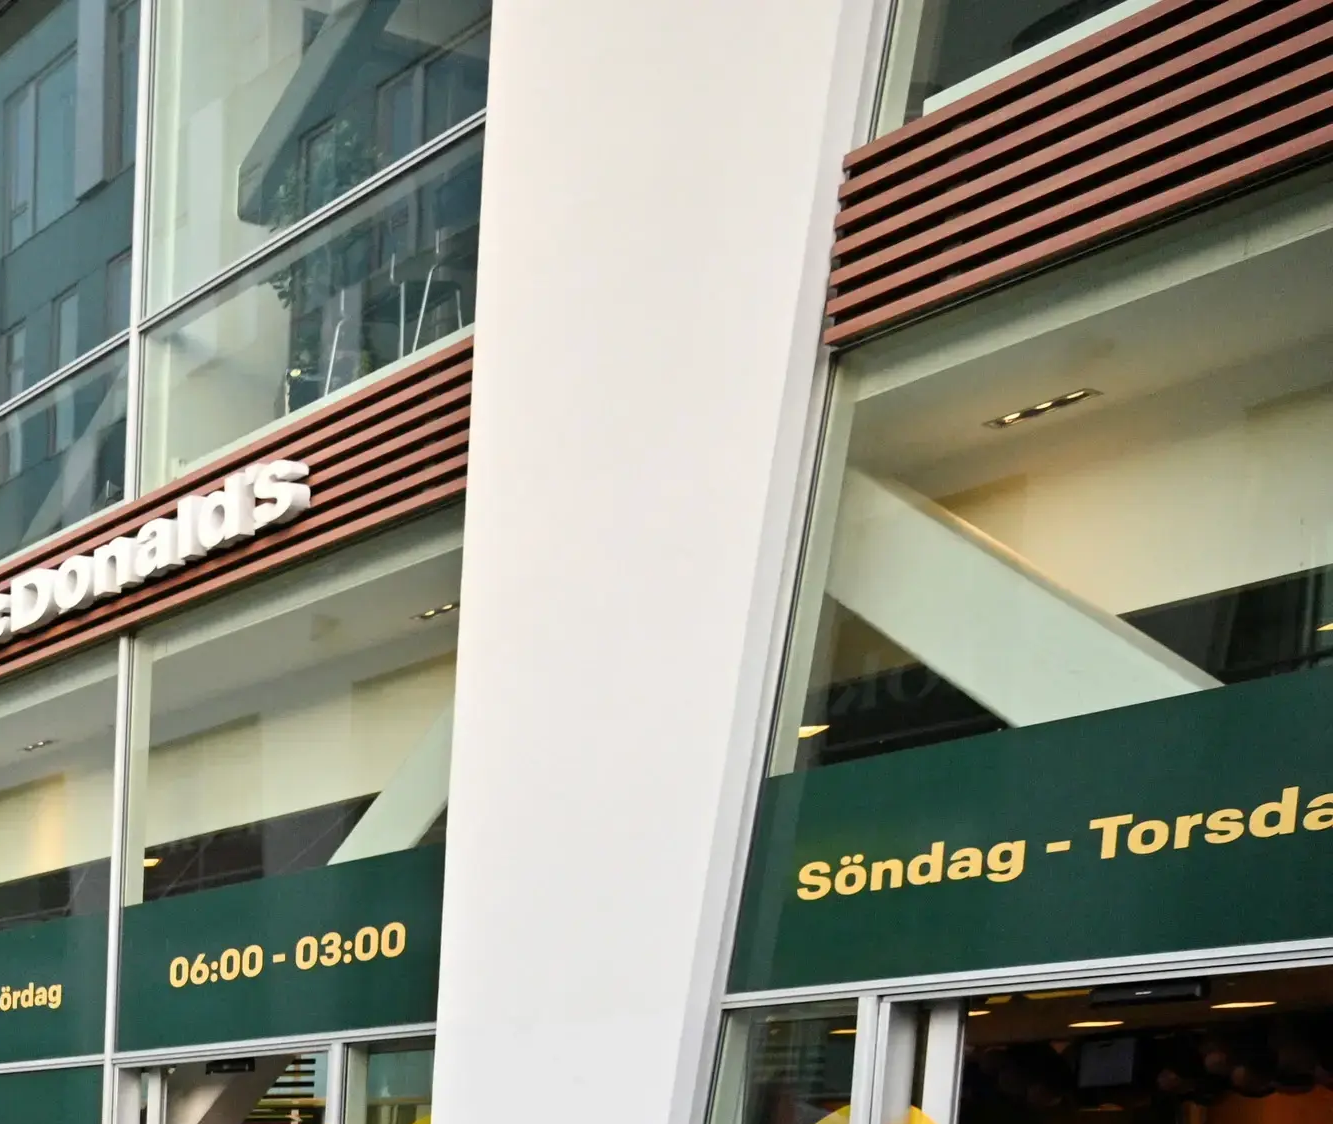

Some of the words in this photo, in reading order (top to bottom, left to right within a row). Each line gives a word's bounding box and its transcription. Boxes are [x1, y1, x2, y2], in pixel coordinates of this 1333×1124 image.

[796, 839, 1027, 901] Söndag
[1045, 840, 1072, 854] -
[169, 944, 263, 988] 06:00
[272, 953, 286, 964] -
[294, 921, 407, 970] 03:00
